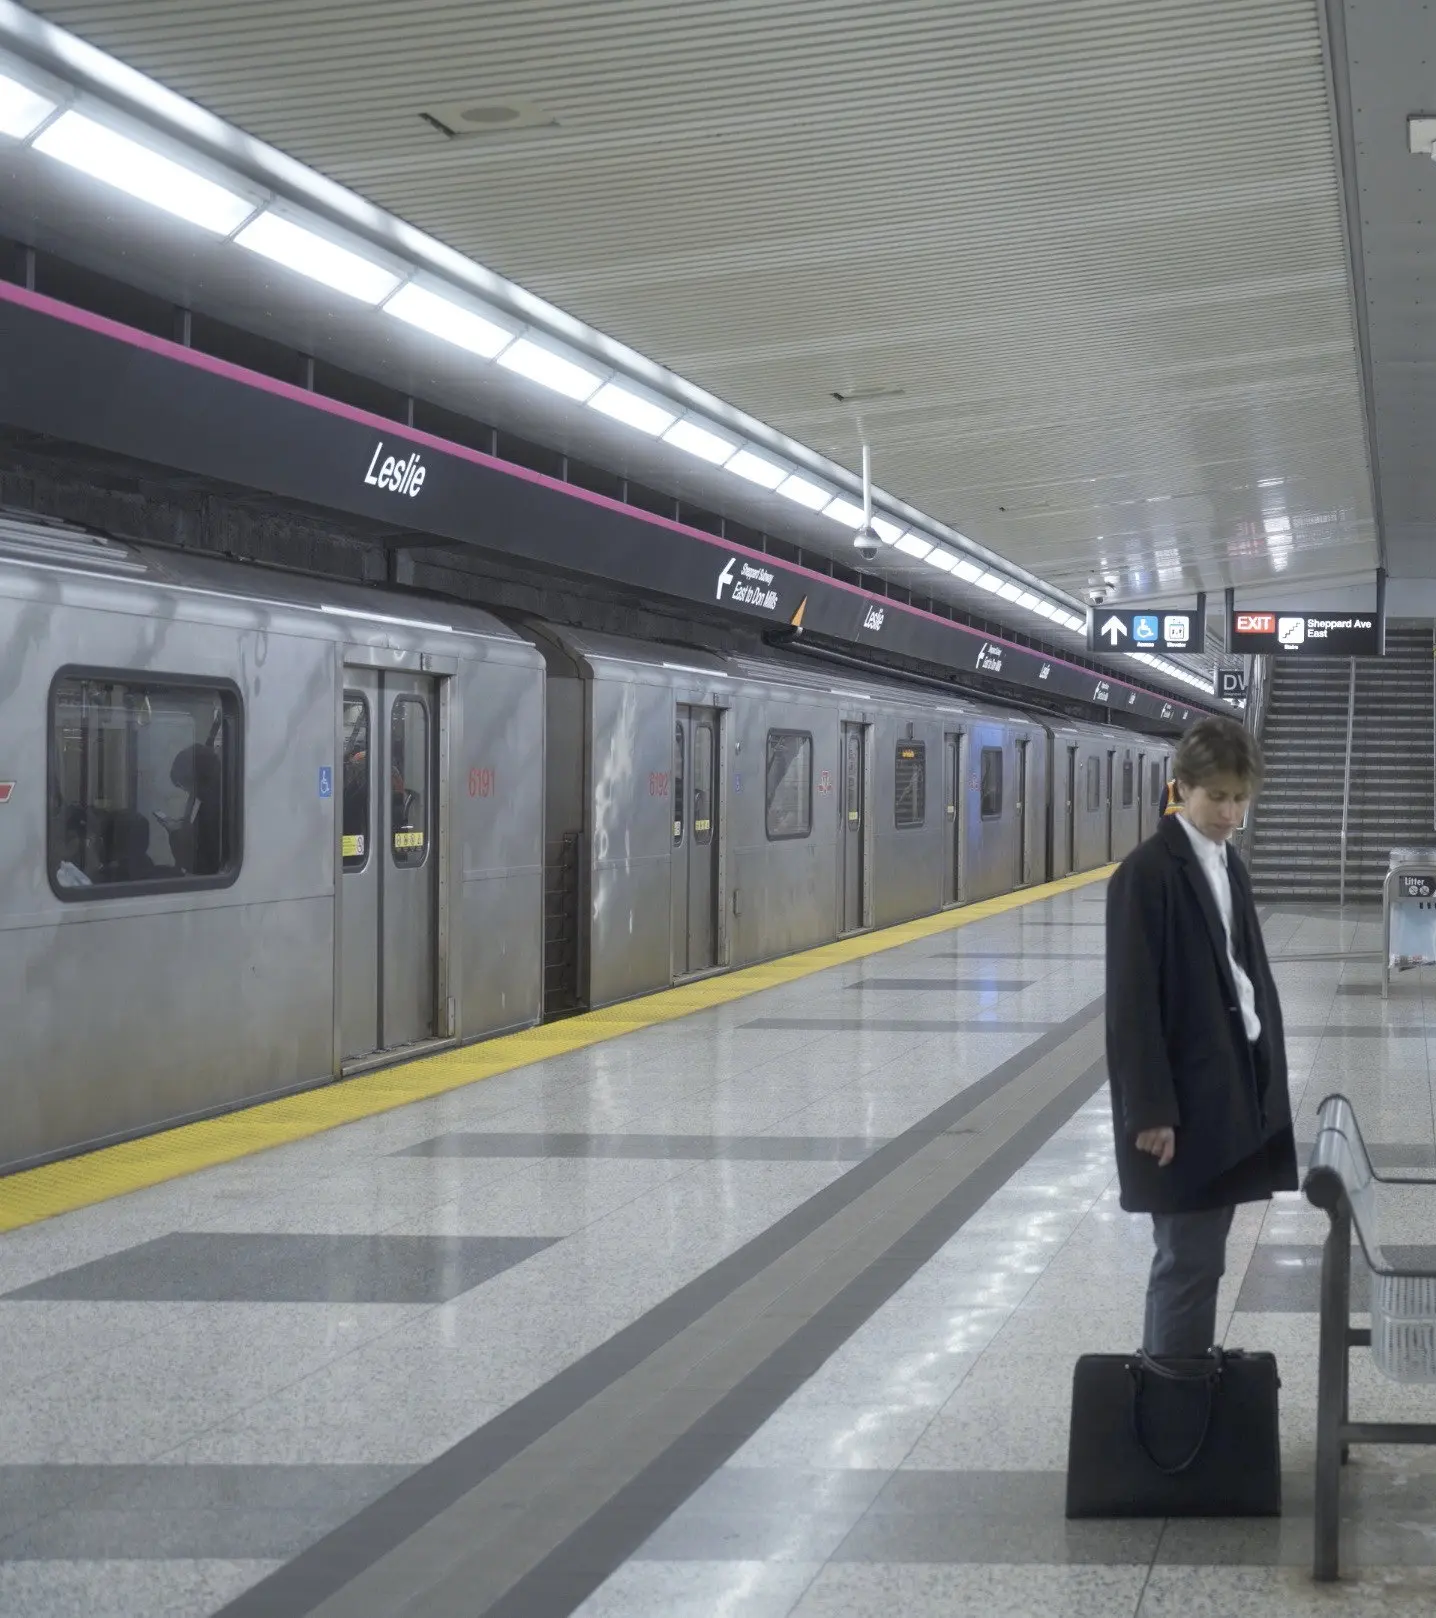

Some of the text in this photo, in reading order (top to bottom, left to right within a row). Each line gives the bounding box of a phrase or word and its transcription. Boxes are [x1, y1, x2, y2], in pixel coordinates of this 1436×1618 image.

[364, 441, 426, 497] Leslie
[732, 581, 748, 601] East
[751, 587, 766, 606] Don
[863, 605, 885, 631] Leslie
[1237, 616, 1272, 630] EXIT
[1307, 619, 1372, 630] Sheppard Ave
[1307, 629, 1328, 638] East
[469, 767, 495, 798] 6191
[1404, 877, 1425, 886] Litter
